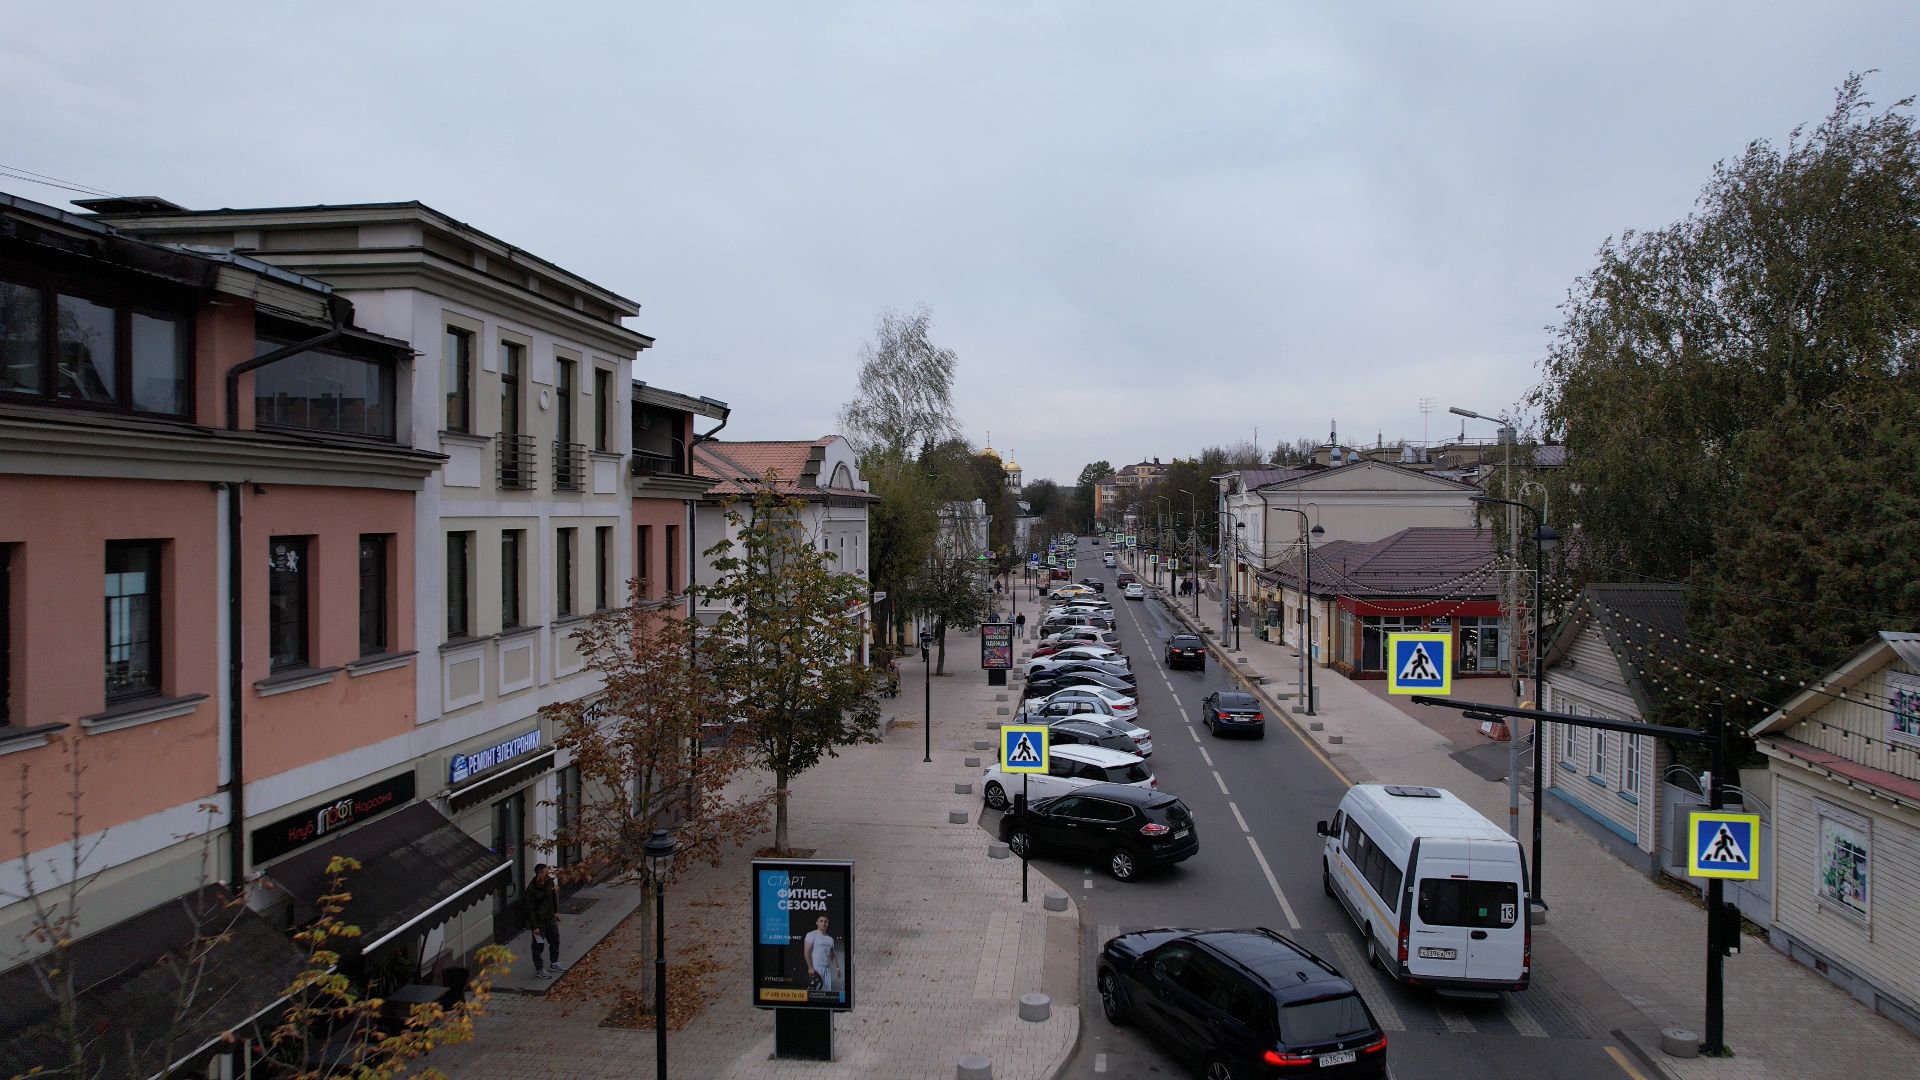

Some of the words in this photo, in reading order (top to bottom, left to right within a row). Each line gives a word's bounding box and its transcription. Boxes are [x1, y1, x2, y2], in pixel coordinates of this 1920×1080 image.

[468, 747, 495, 775] РЕМОНТ
[496, 729, 541, 764] ЭЛЕКТРОНИКИ
[288, 818, 315, 842] Клуб
[354, 791, 393, 815] Караоке
[767, 875, 806, 887] СТАРТ
[777, 888, 833, 900] ФИТНЕС-
[777, 900, 827, 911] СЕЗОНА
[1502, 907, 1513, 919] 13
